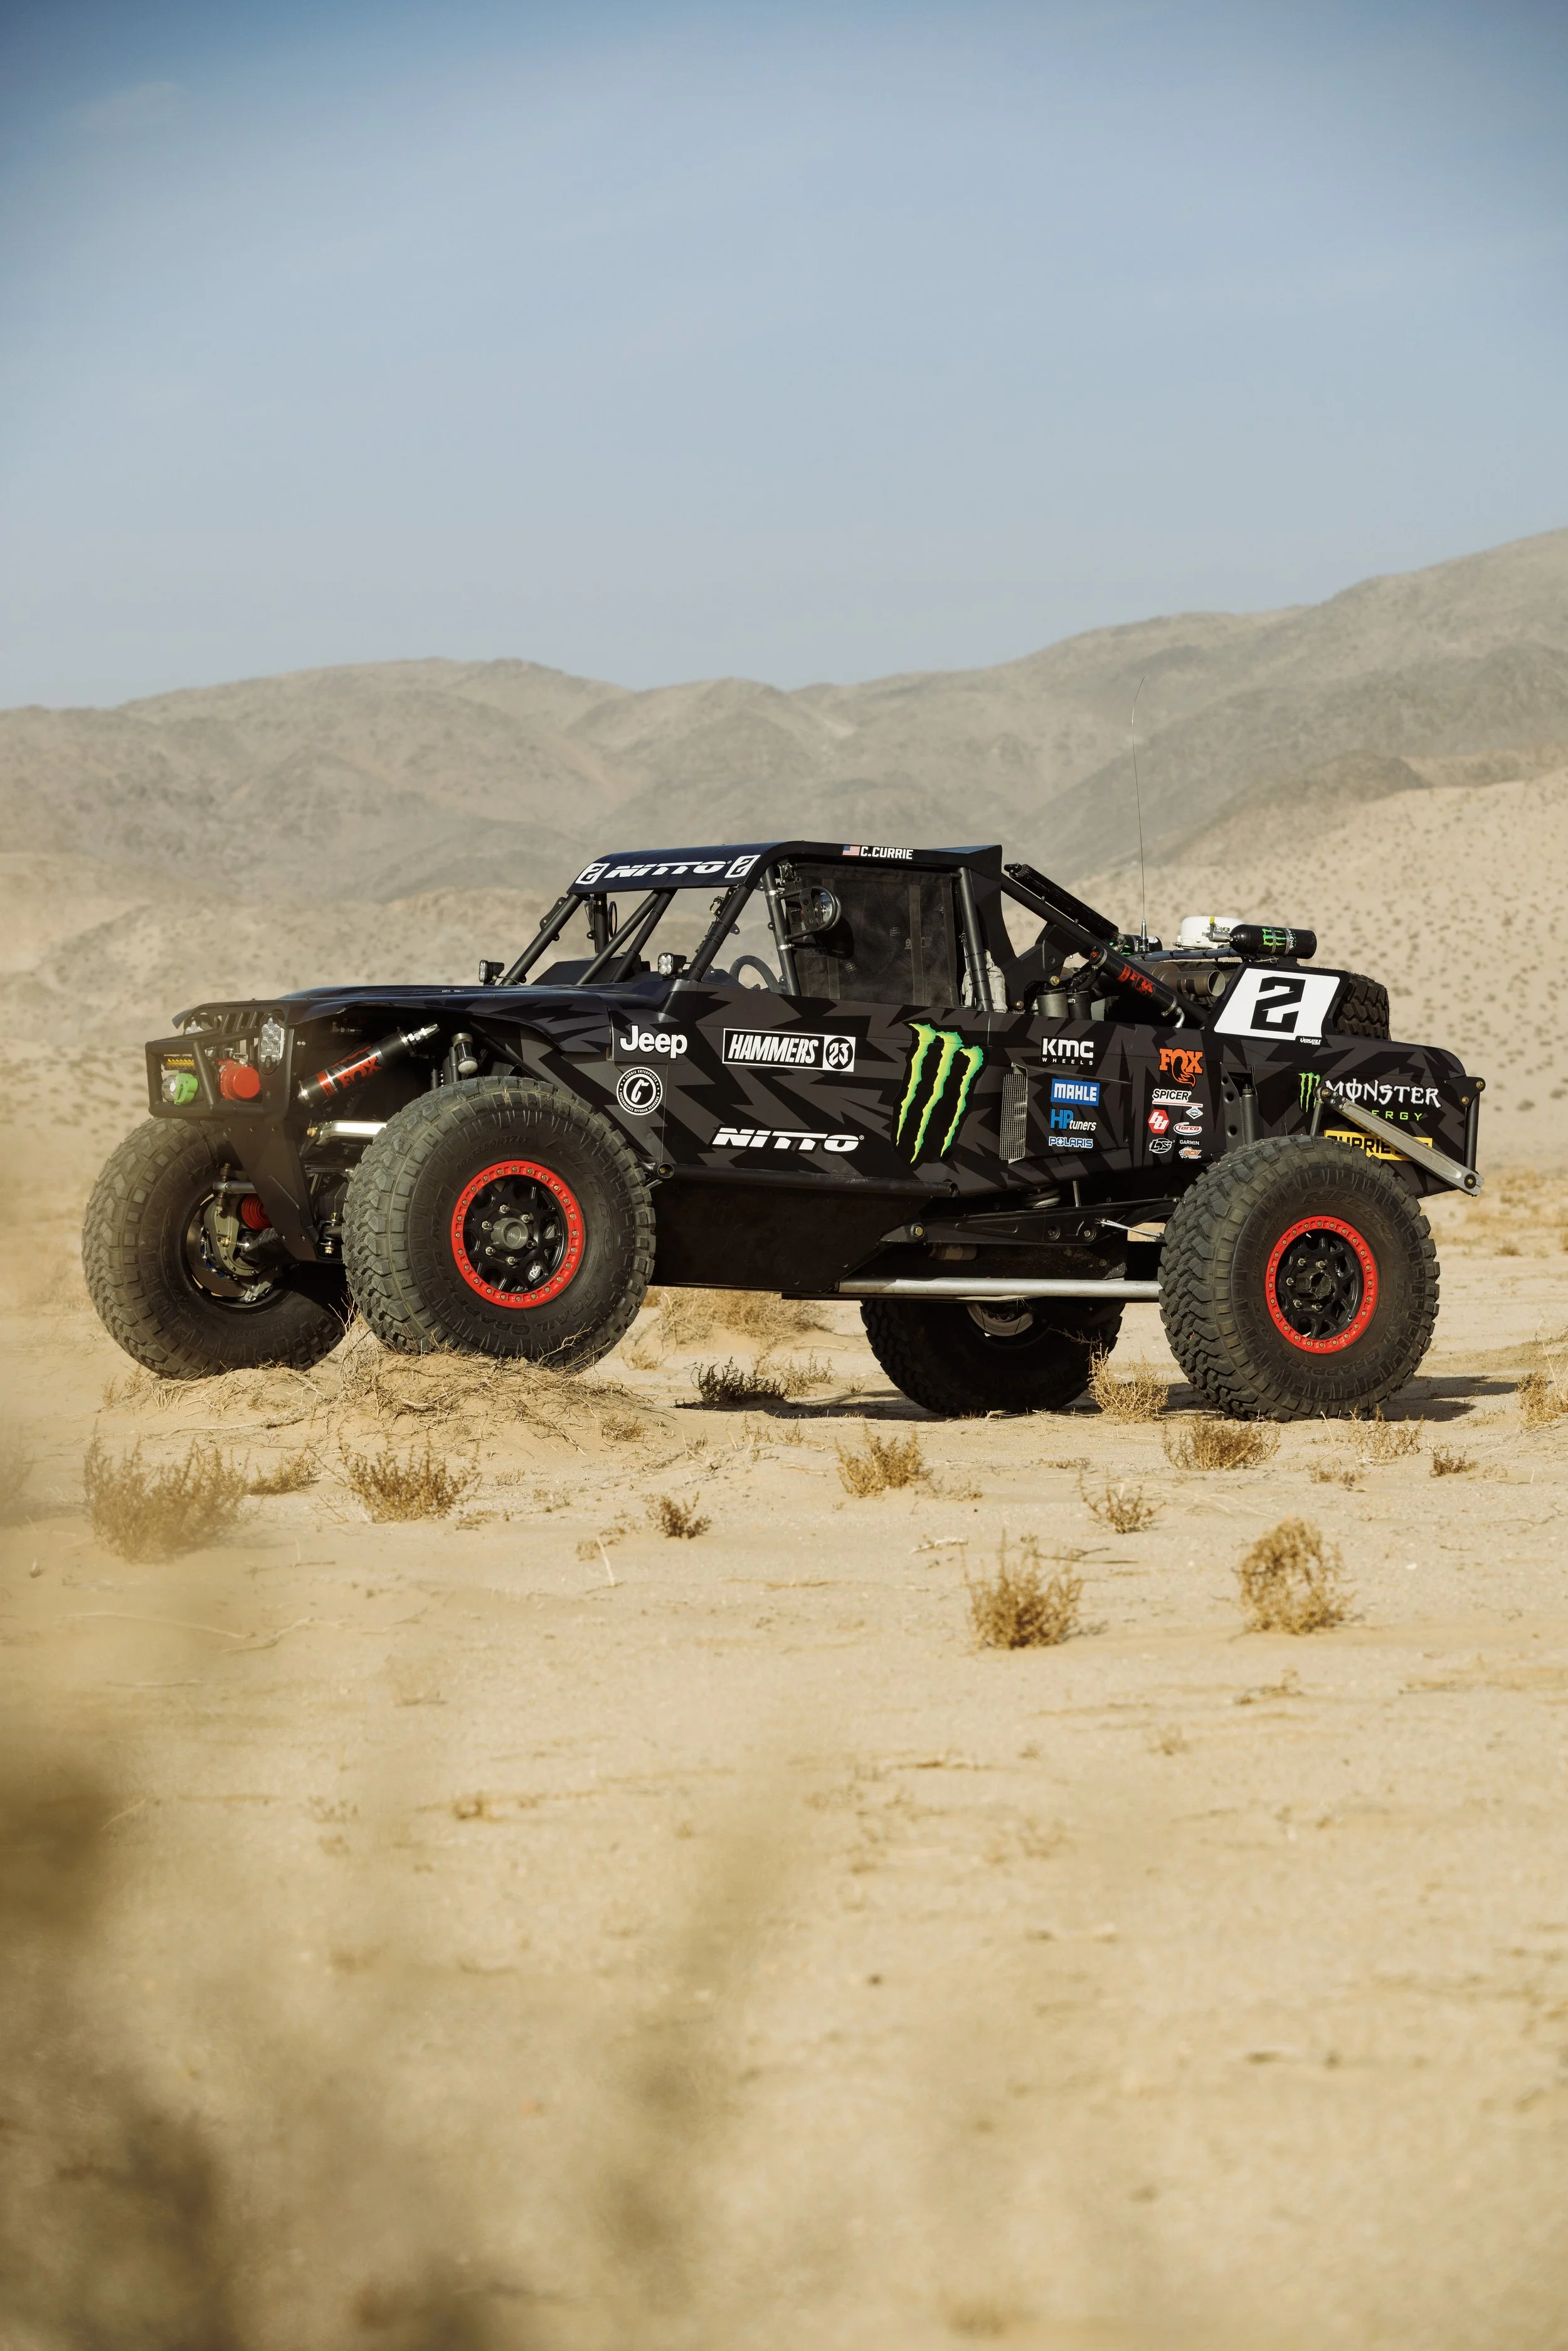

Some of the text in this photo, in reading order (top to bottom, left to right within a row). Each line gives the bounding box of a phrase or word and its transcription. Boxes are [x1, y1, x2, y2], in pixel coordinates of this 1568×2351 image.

[861, 846, 913, 859] C.CURRIE
[603, 861, 727, 878] NITTO
[1250, 977, 1306, 1033] 2
[620, 1025, 687, 1059] Jeep
[728, 1034, 850, 1066] HAMMERS 23
[1042, 1038, 1094, 1058] KMC
[336, 1055, 383, 1090] FOX
[625, 1069, 659, 1083] CURRIE ENTERPRISES
[1160, 1048, 1203, 1086] FOX
[1054, 1083, 1098, 1102] MAHLE
[1153, 1090, 1189, 1101] SPICER
[1372, 1110, 1422, 1122] ERGY
[712, 1127, 859, 1152] NITTO
[1049, 1136, 1094, 1149] POLARIS
